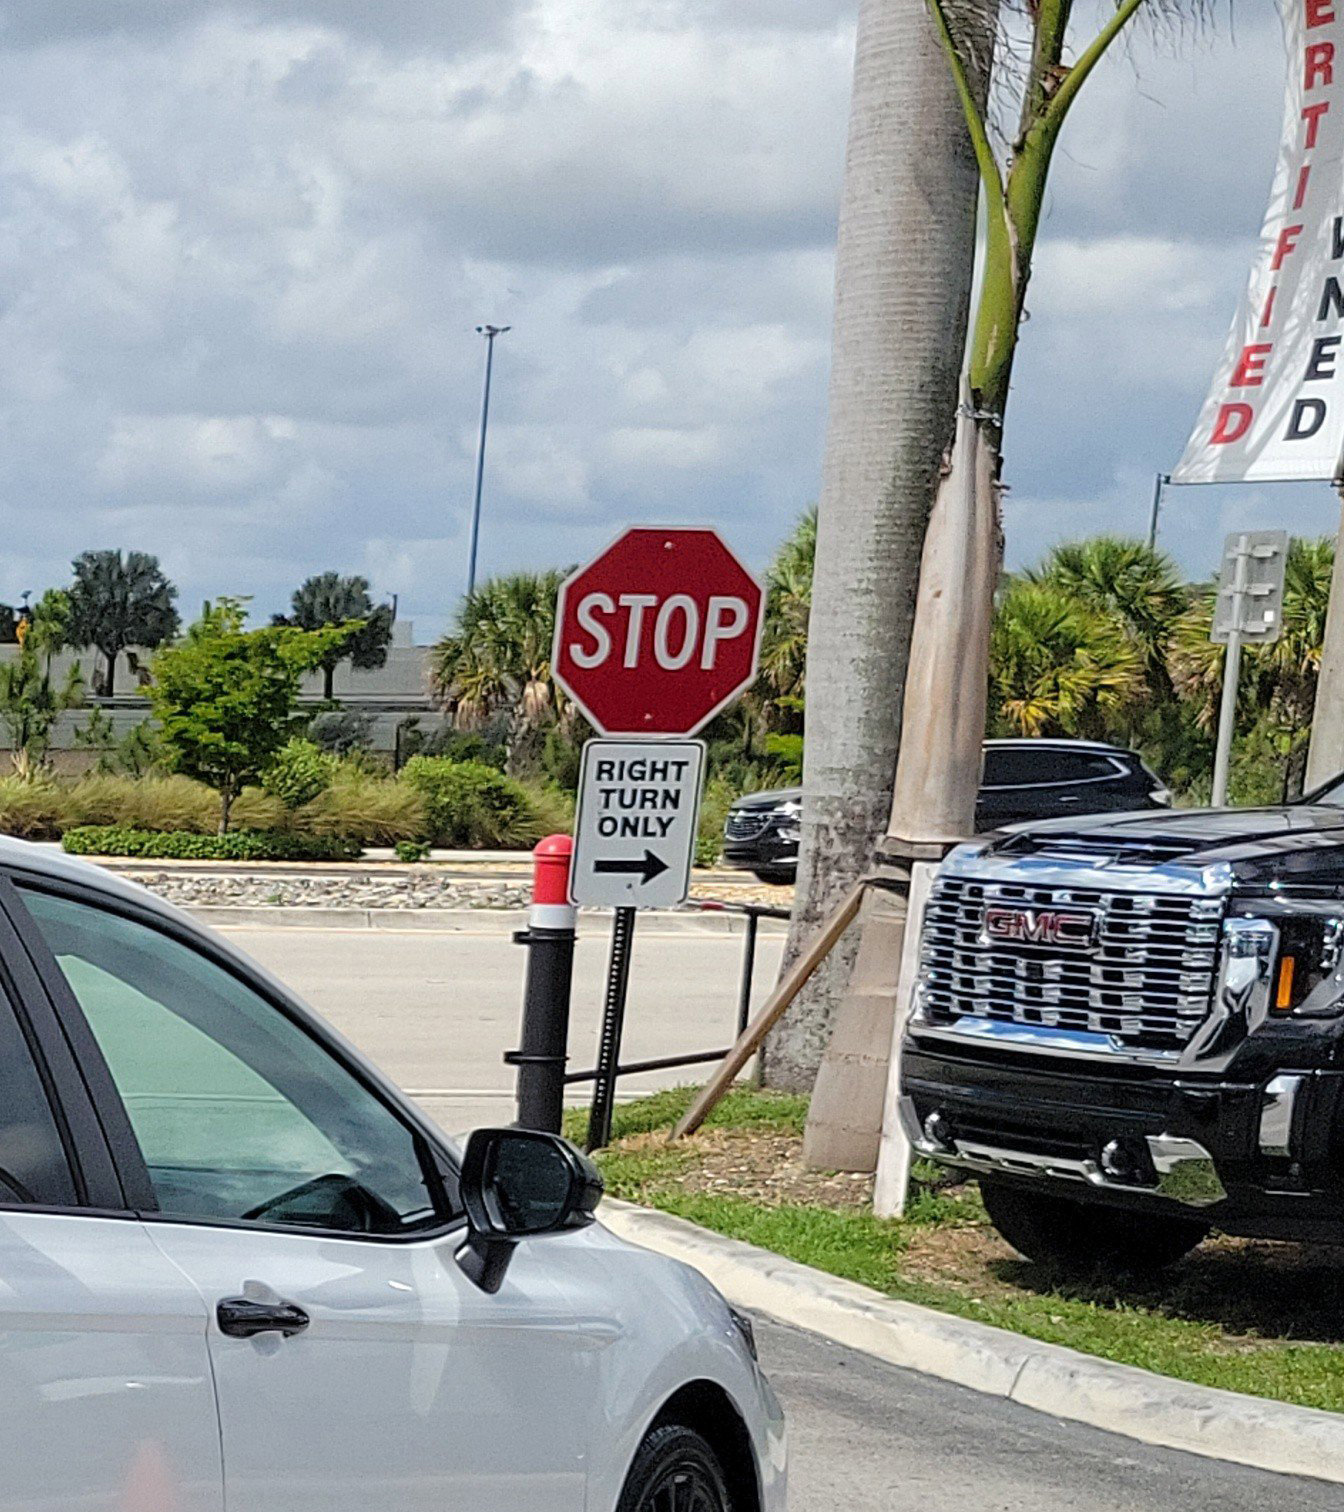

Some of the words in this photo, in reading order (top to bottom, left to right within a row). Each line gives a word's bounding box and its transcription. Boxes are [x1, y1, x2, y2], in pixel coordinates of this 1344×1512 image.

[569, 592, 749, 671] STOP
[596, 760, 689, 782] RIGHT
[599, 788, 681, 810] TURN
[598, 816, 675, 838] ONLY
[986, 907, 1094, 947] GMC
